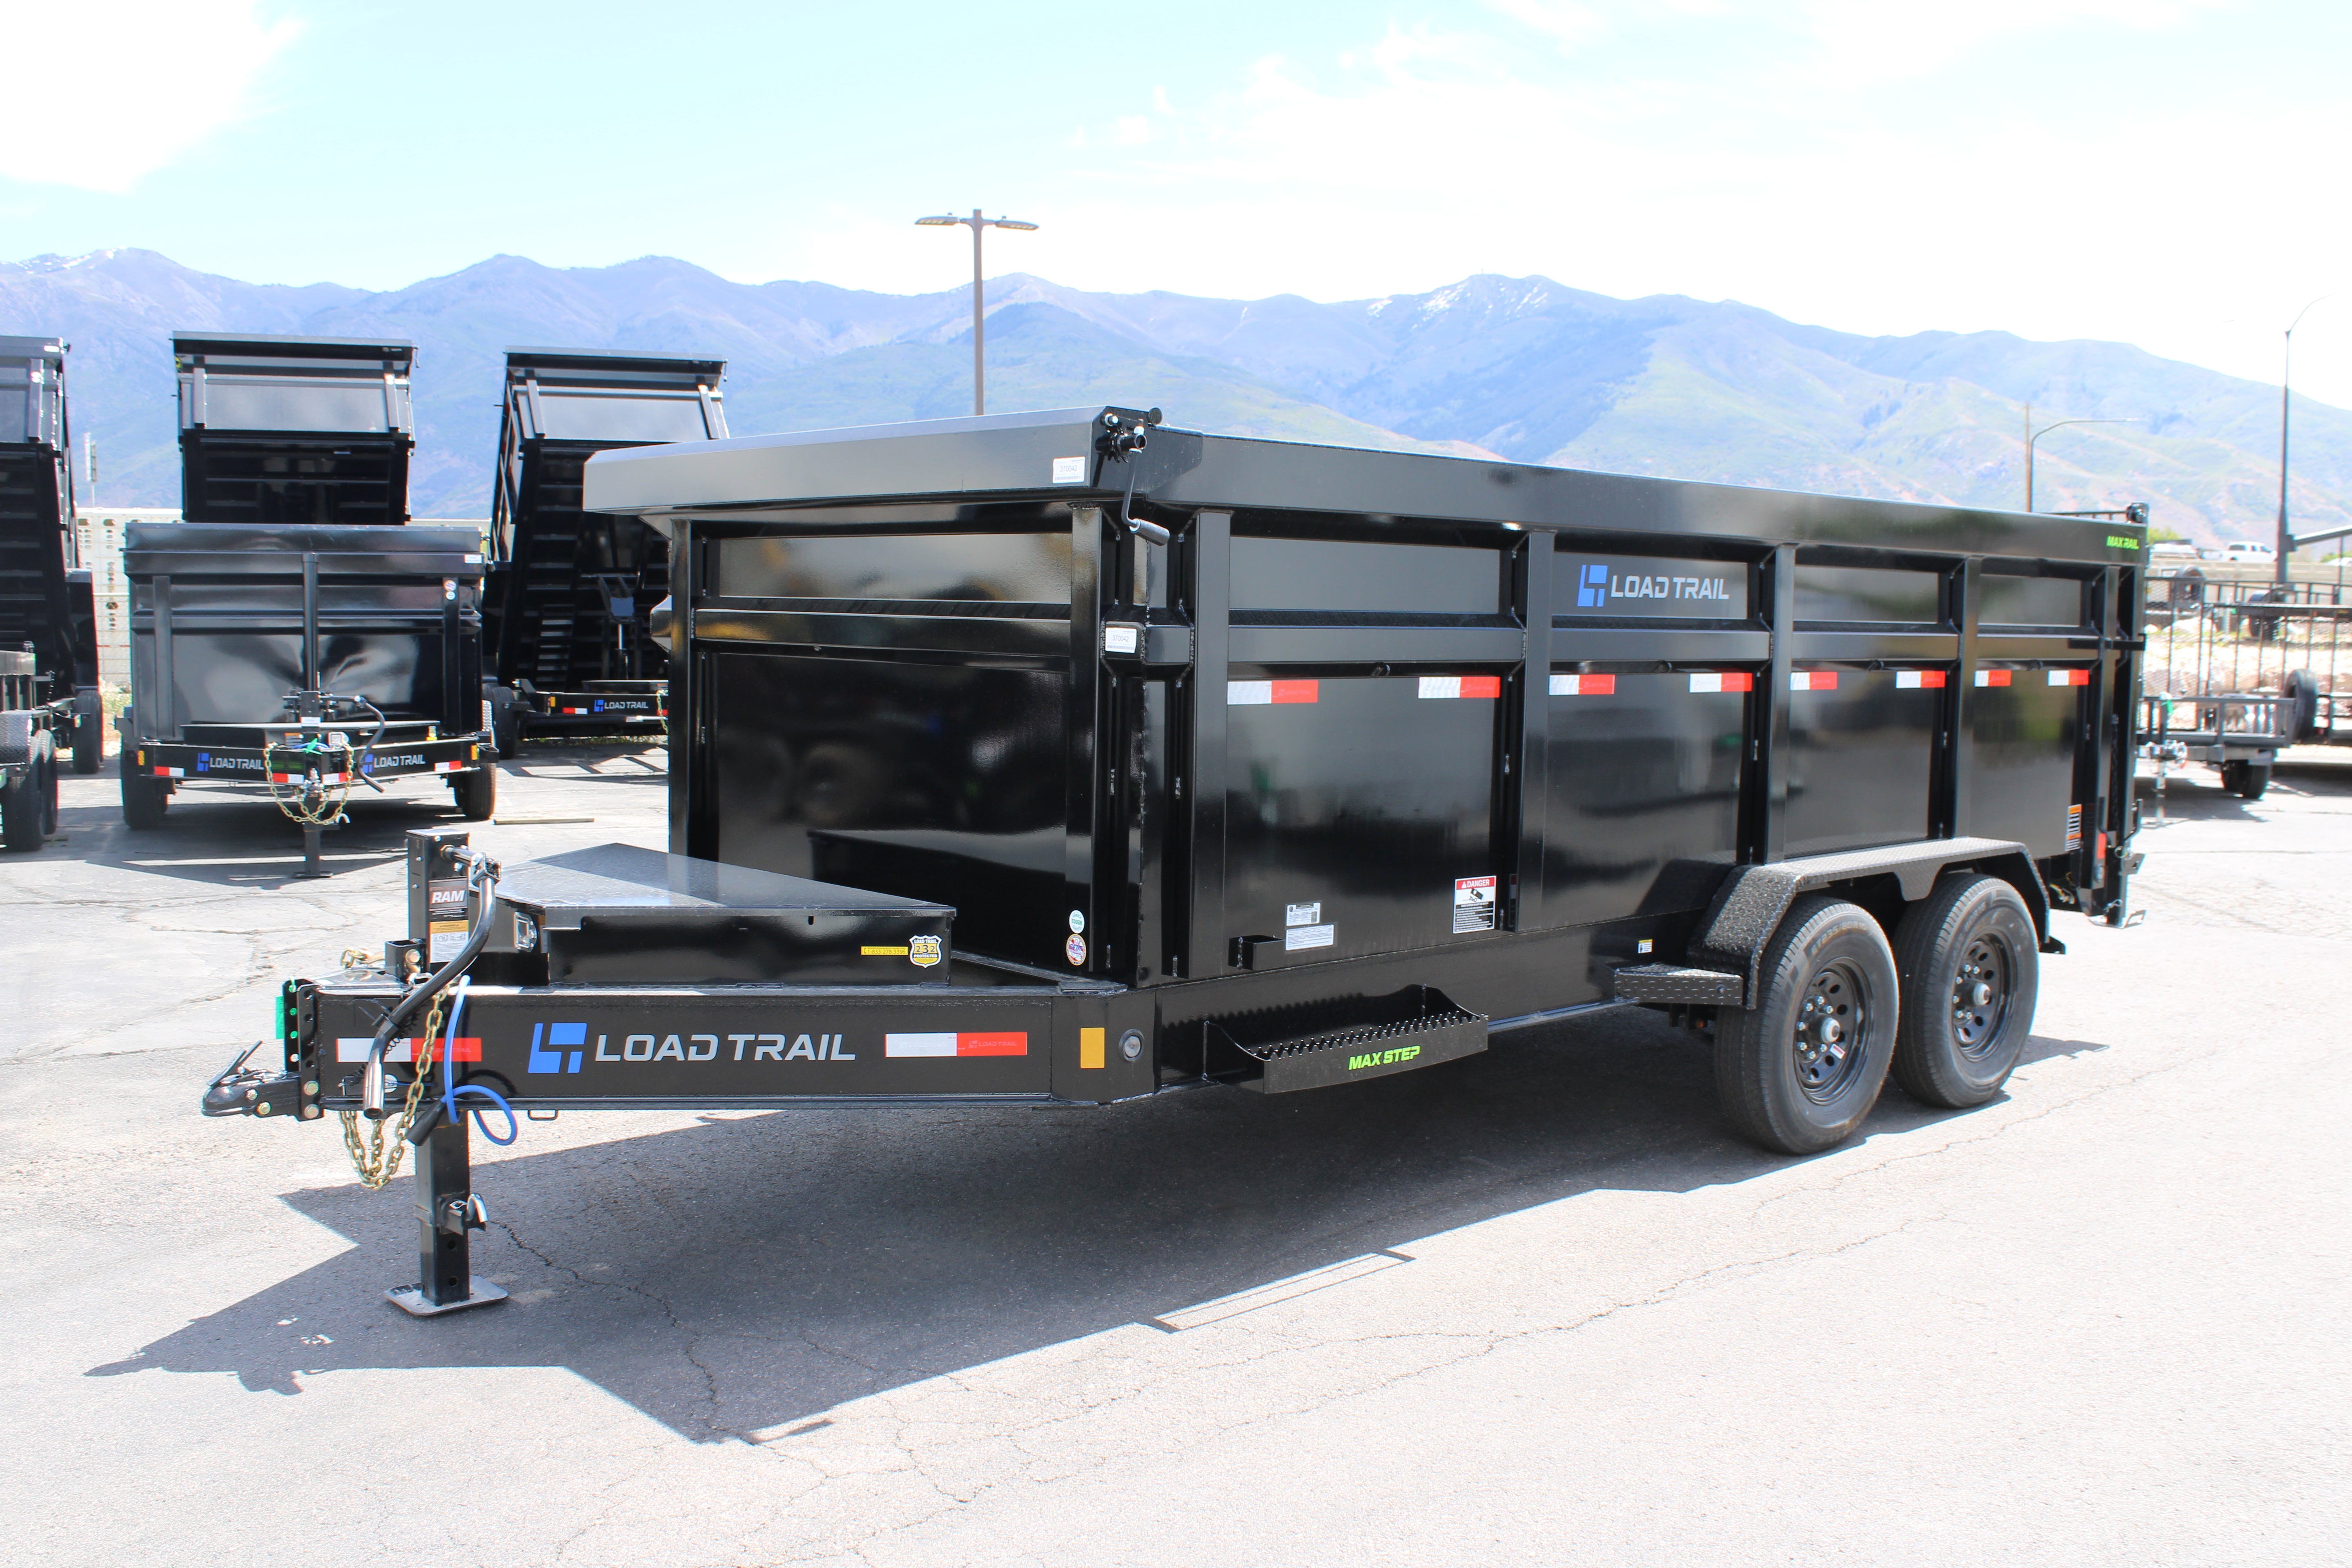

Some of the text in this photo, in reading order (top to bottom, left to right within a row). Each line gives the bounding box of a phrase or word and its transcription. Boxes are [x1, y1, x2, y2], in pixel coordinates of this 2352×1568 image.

[2106, 535, 2124, 548] MAX
[1610, 575, 1730, 600] LOAD TRAIL
[209, 757, 265, 770] LOAD TRAIL
[374, 755, 426, 768] LOAD TRAIL
[1467, 879, 1490, 887] DANGER
[430, 890, 466, 904] RAM
[595, 1034, 856, 1062] LOAD TRAIL
[1348, 1045, 1421, 1070] MAX STEP
